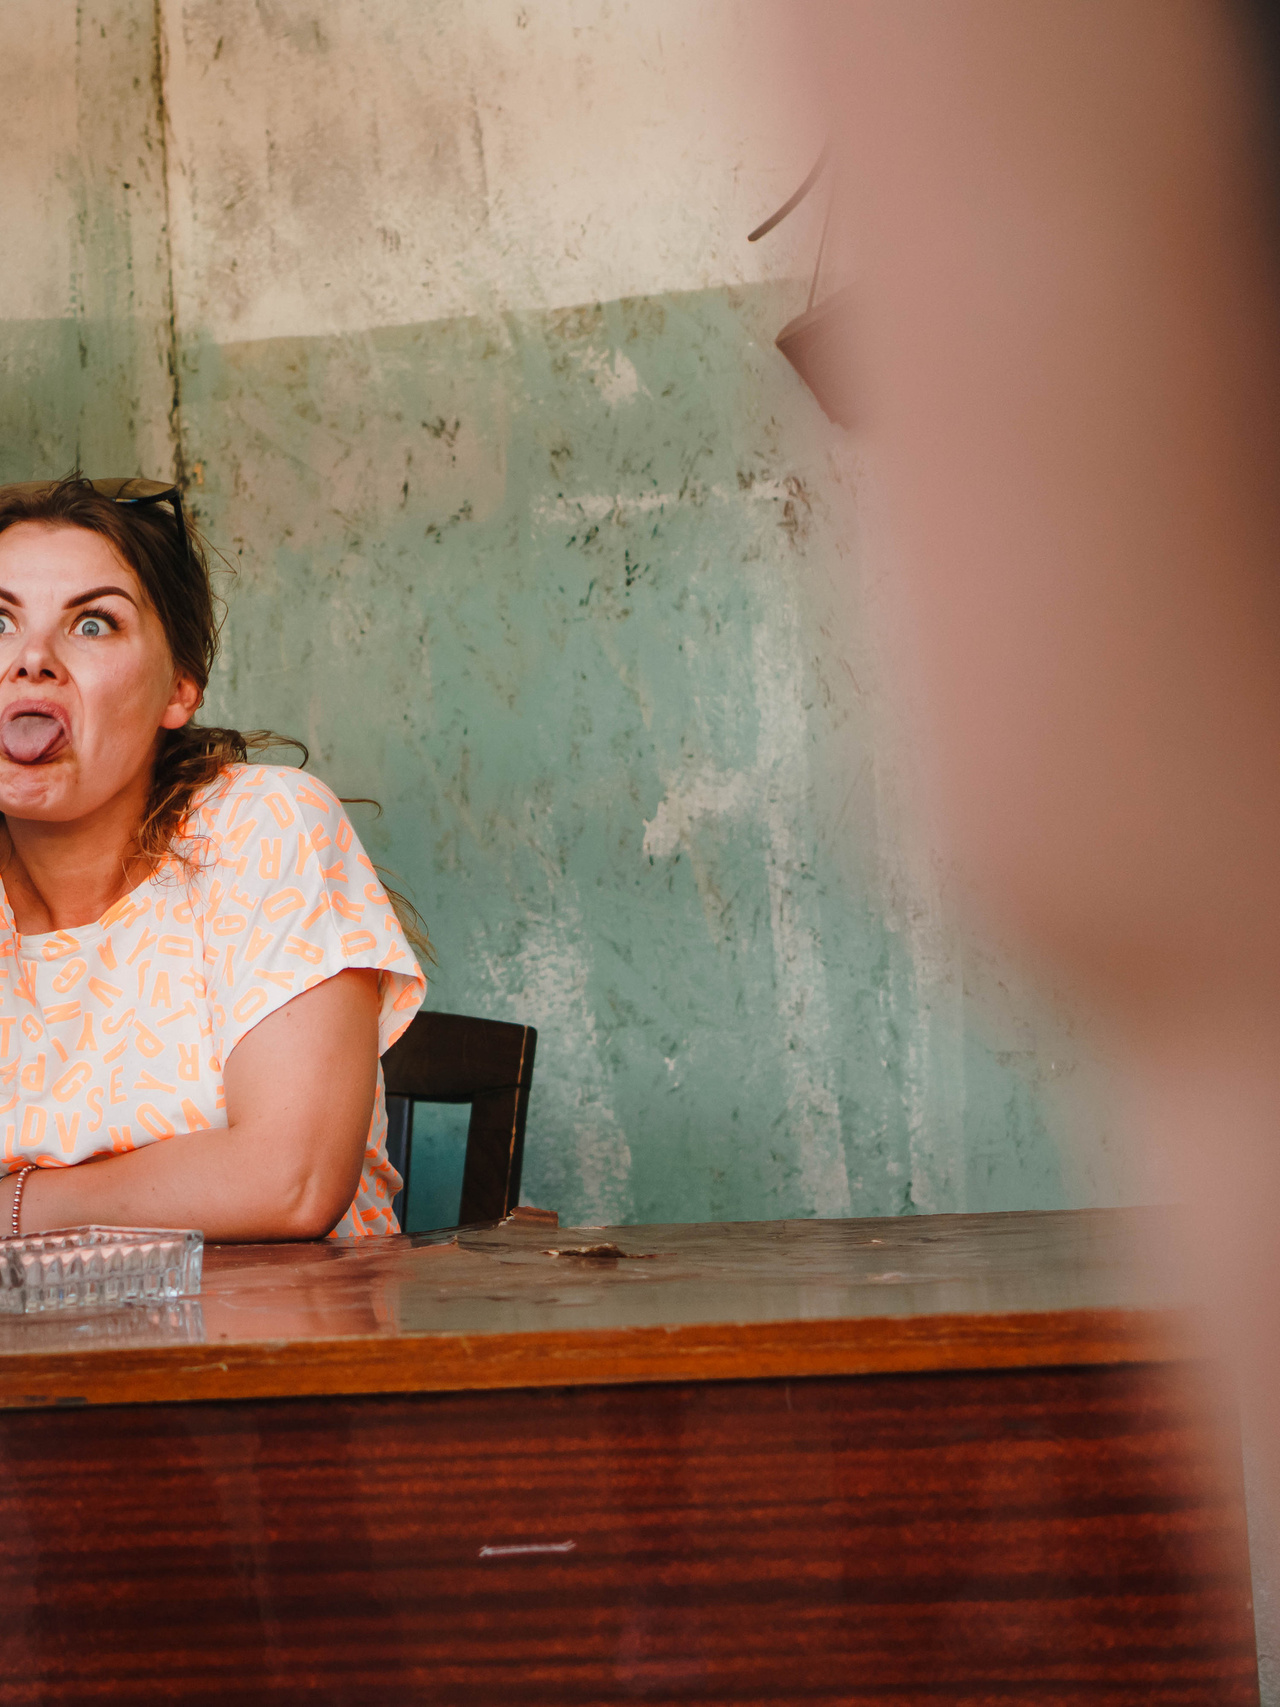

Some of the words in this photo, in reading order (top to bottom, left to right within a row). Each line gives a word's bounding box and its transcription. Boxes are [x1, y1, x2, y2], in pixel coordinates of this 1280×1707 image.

[258, 838, 282, 880] R
[212, 914, 247, 936] G
[125, 926, 158, 966] Y
[284, 934, 324, 965] R
[52, 957, 88, 993] G
[150, 971, 172, 1008] A
[101, 1008, 136, 1035] S
[156, 1000, 197, 1028] T
[233, 986, 268, 1024] O
[76, 1012, 98, 1050] Y
[134, 1019, 166, 1058] P
[177, 1043, 200, 1081] R
[52, 1061, 92, 1102] G
[110, 1066, 128, 1104] E
[134, 1070, 177, 1094] Y
[20, 1105, 47, 1146] D
[86, 1086, 104, 1132] S
[181, 1098, 212, 1133] A
[54, 1112, 82, 1153] V
